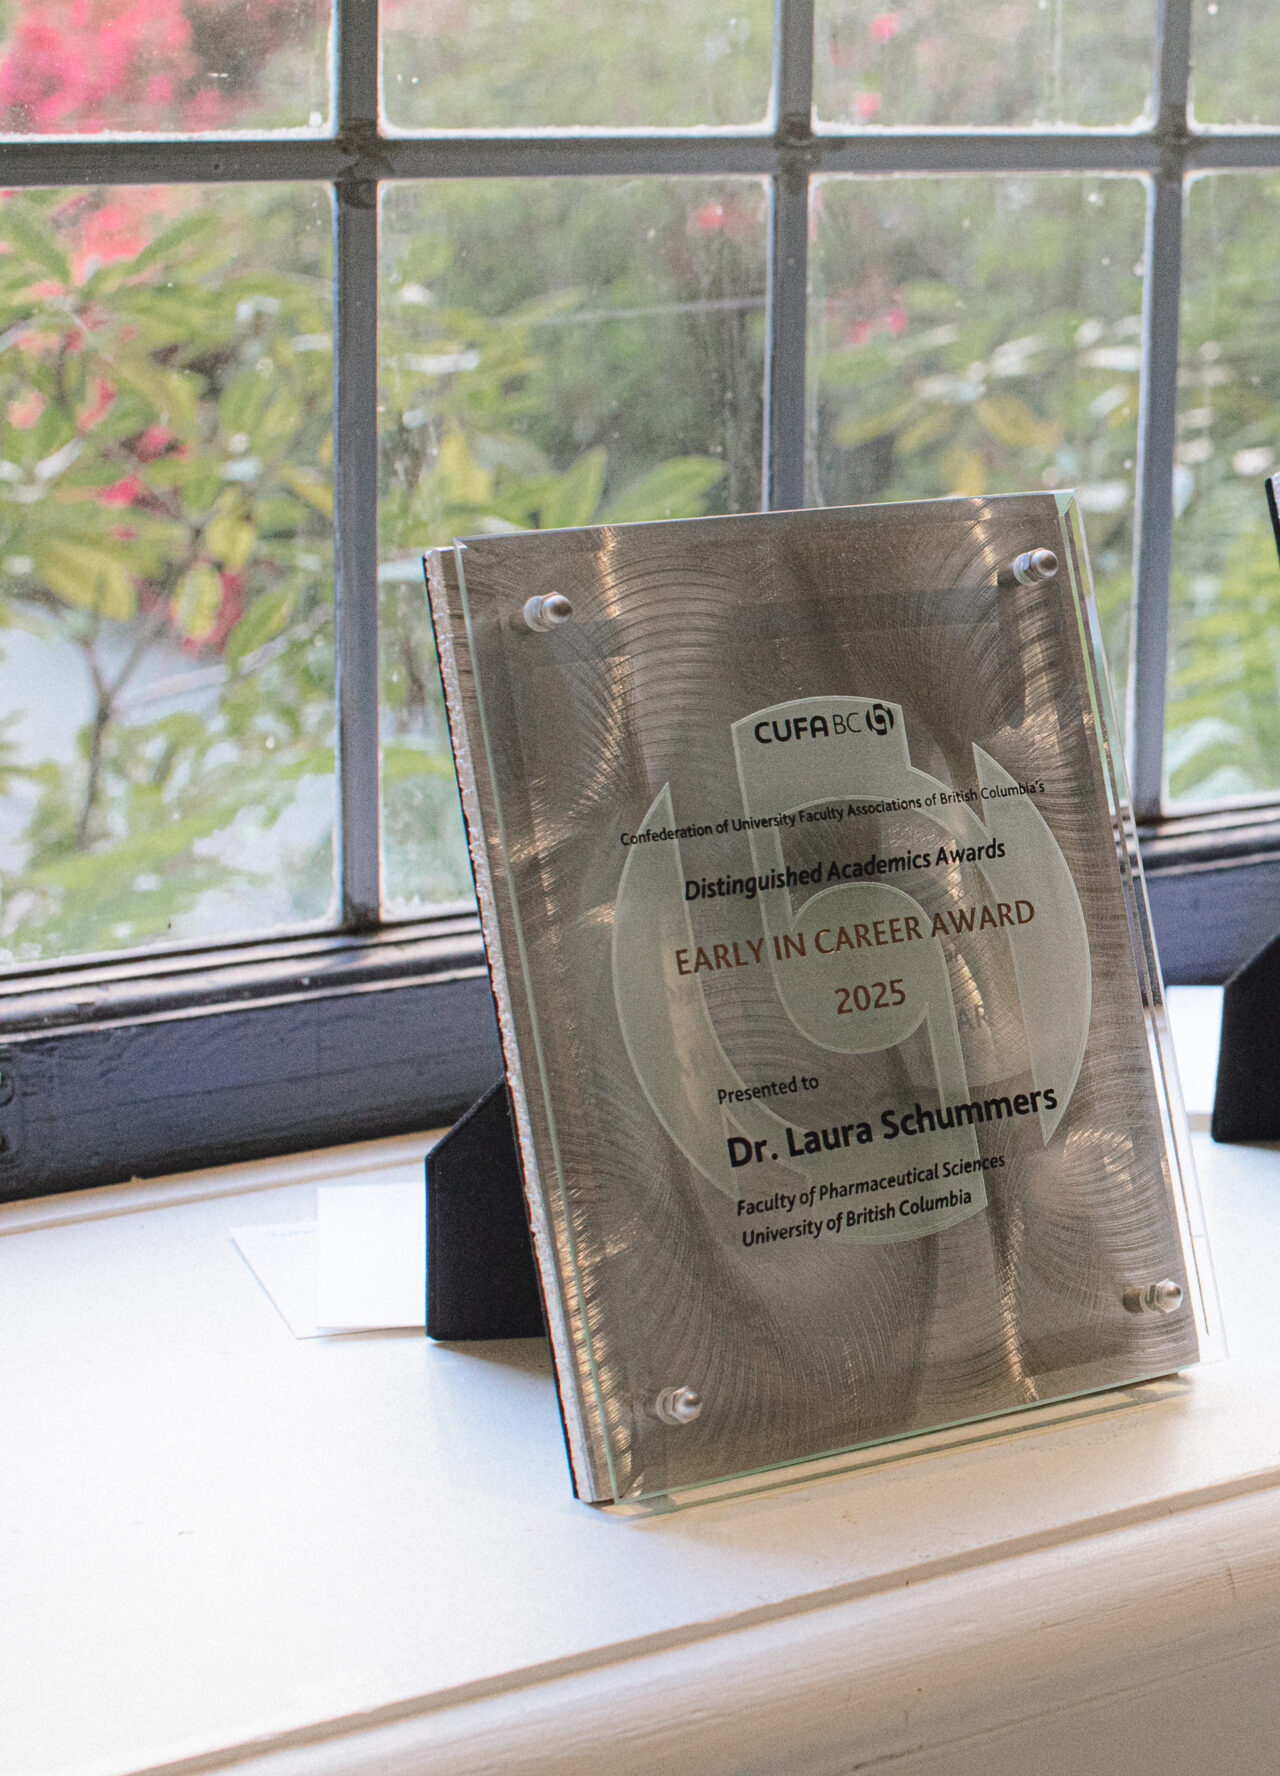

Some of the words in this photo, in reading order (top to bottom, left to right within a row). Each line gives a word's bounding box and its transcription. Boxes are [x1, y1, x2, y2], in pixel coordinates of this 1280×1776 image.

[619, 822, 714, 847] Confederation
[715, 818, 729, 834] of
[731, 811, 796, 832] University
[799, 804, 845, 825] Faculty
[847, 795, 923, 817] Associations
[925, 791, 938, 807] of
[940, 785, 979, 804] British
[981, 778, 1046, 801] Columbia's
[684, 861, 823, 902] Distinguished
[827, 849, 932, 882] Academics
[935, 839, 1007, 867] Awards
[675, 936, 765, 977] EARLY
[774, 930, 807, 962] IN
[814, 915, 921, 956] CAREER
[930, 899, 1036, 939] AWARD
[834, 978, 907, 1015] 2025
[717, 1076, 798, 1105] Presented
[800, 1074, 820, 1093] to
[727, 1136, 779, 1167] Dr.
[785, 1117, 874, 1158] Laura
[880, 1087, 1059, 1141] Schummers
[736, 1184, 797, 1217] Faculty
[799, 1184, 818, 1206] of
[819, 1163, 939, 1201] Pharmaceutical
[942, 1151, 1006, 1180] Sciences
[741, 1218, 824, 1248] University
[826, 1211, 845, 1234] of
[846, 1201, 896, 1229] British
[899, 1189, 973, 1217] Columbia
